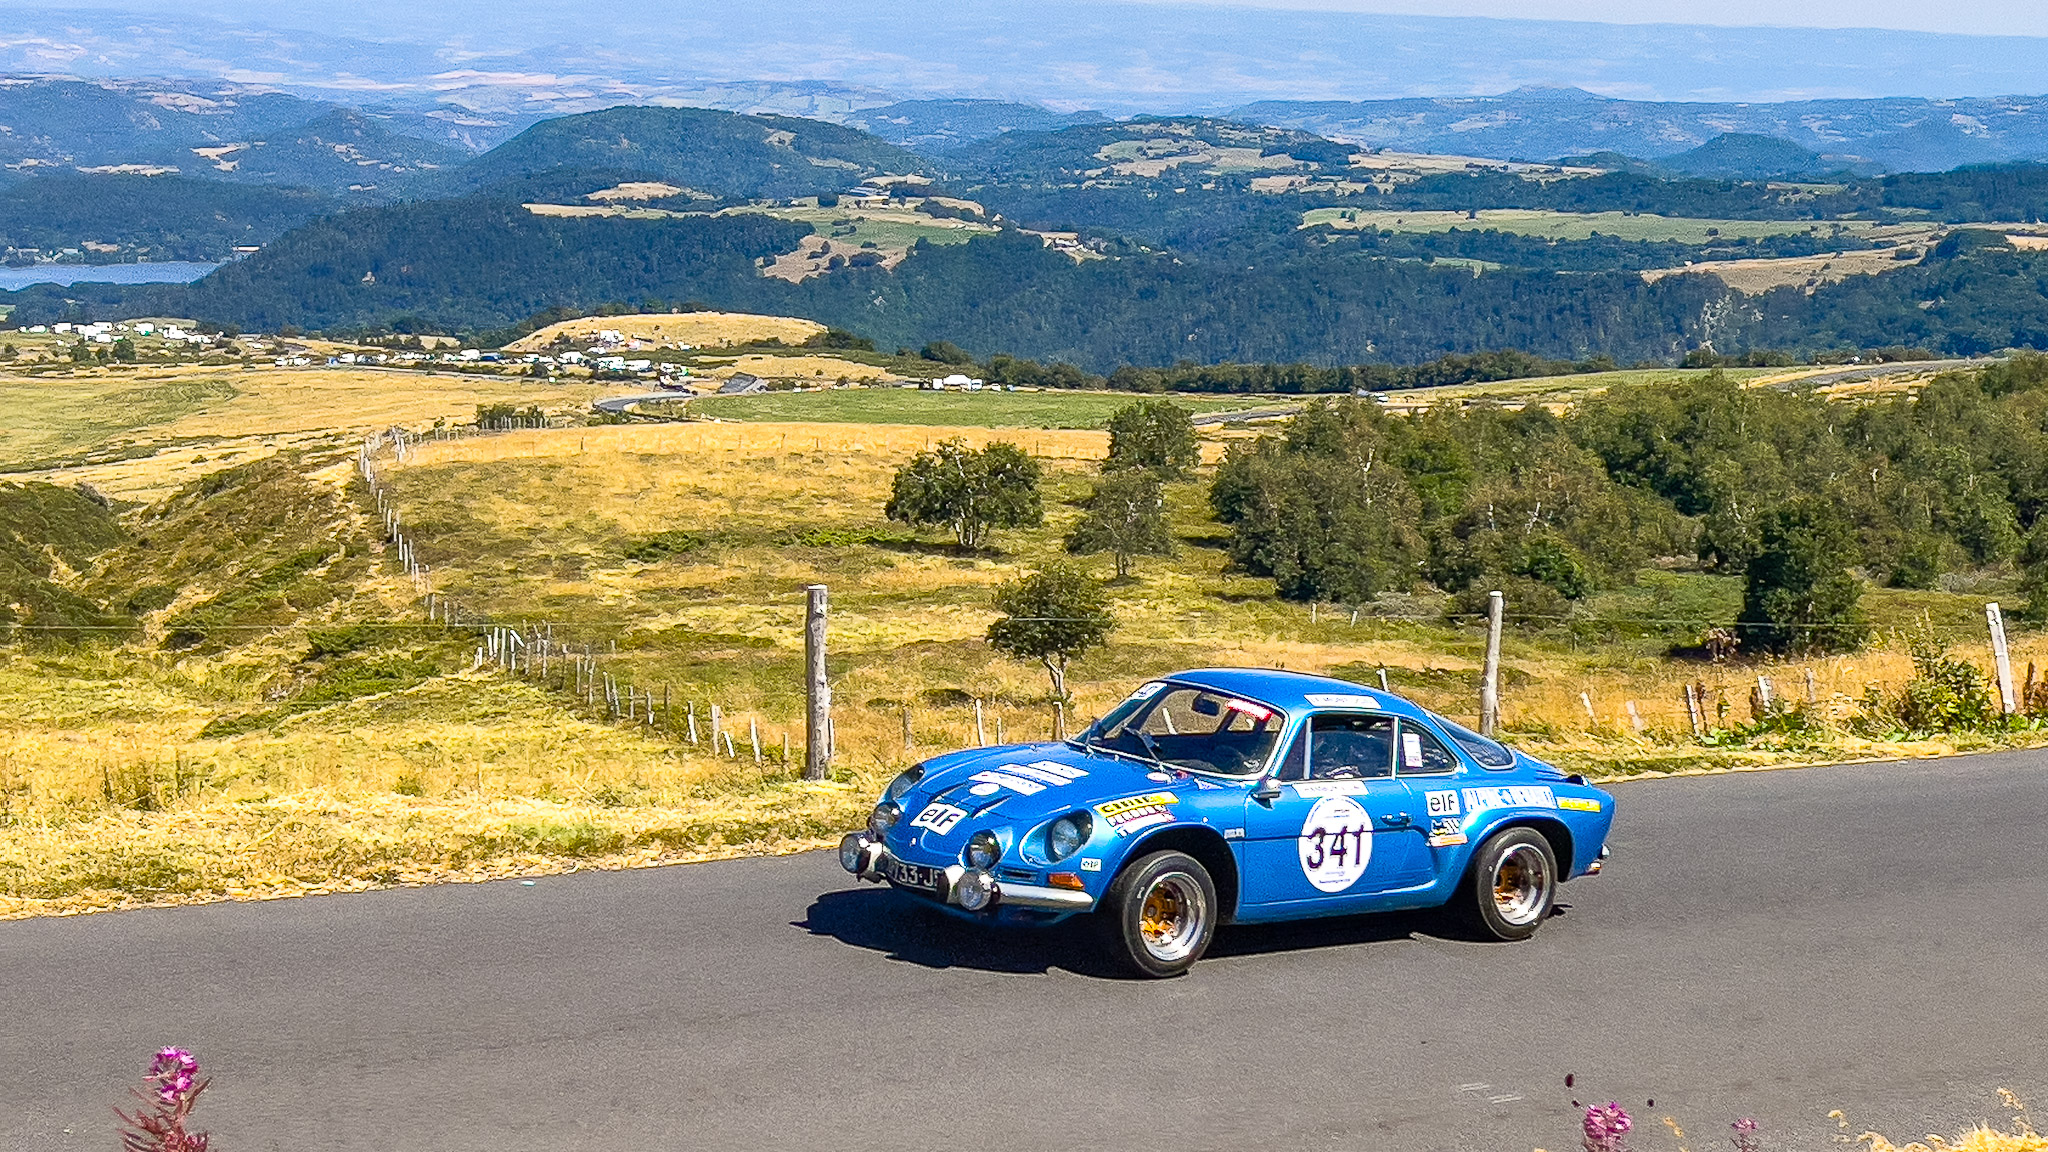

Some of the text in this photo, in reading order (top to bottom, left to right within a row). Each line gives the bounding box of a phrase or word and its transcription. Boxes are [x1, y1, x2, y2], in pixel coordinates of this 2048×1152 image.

[1430, 793, 1455, 812] elf
[919, 808, 961, 828] elf
[1306, 823, 1364, 869] 341
